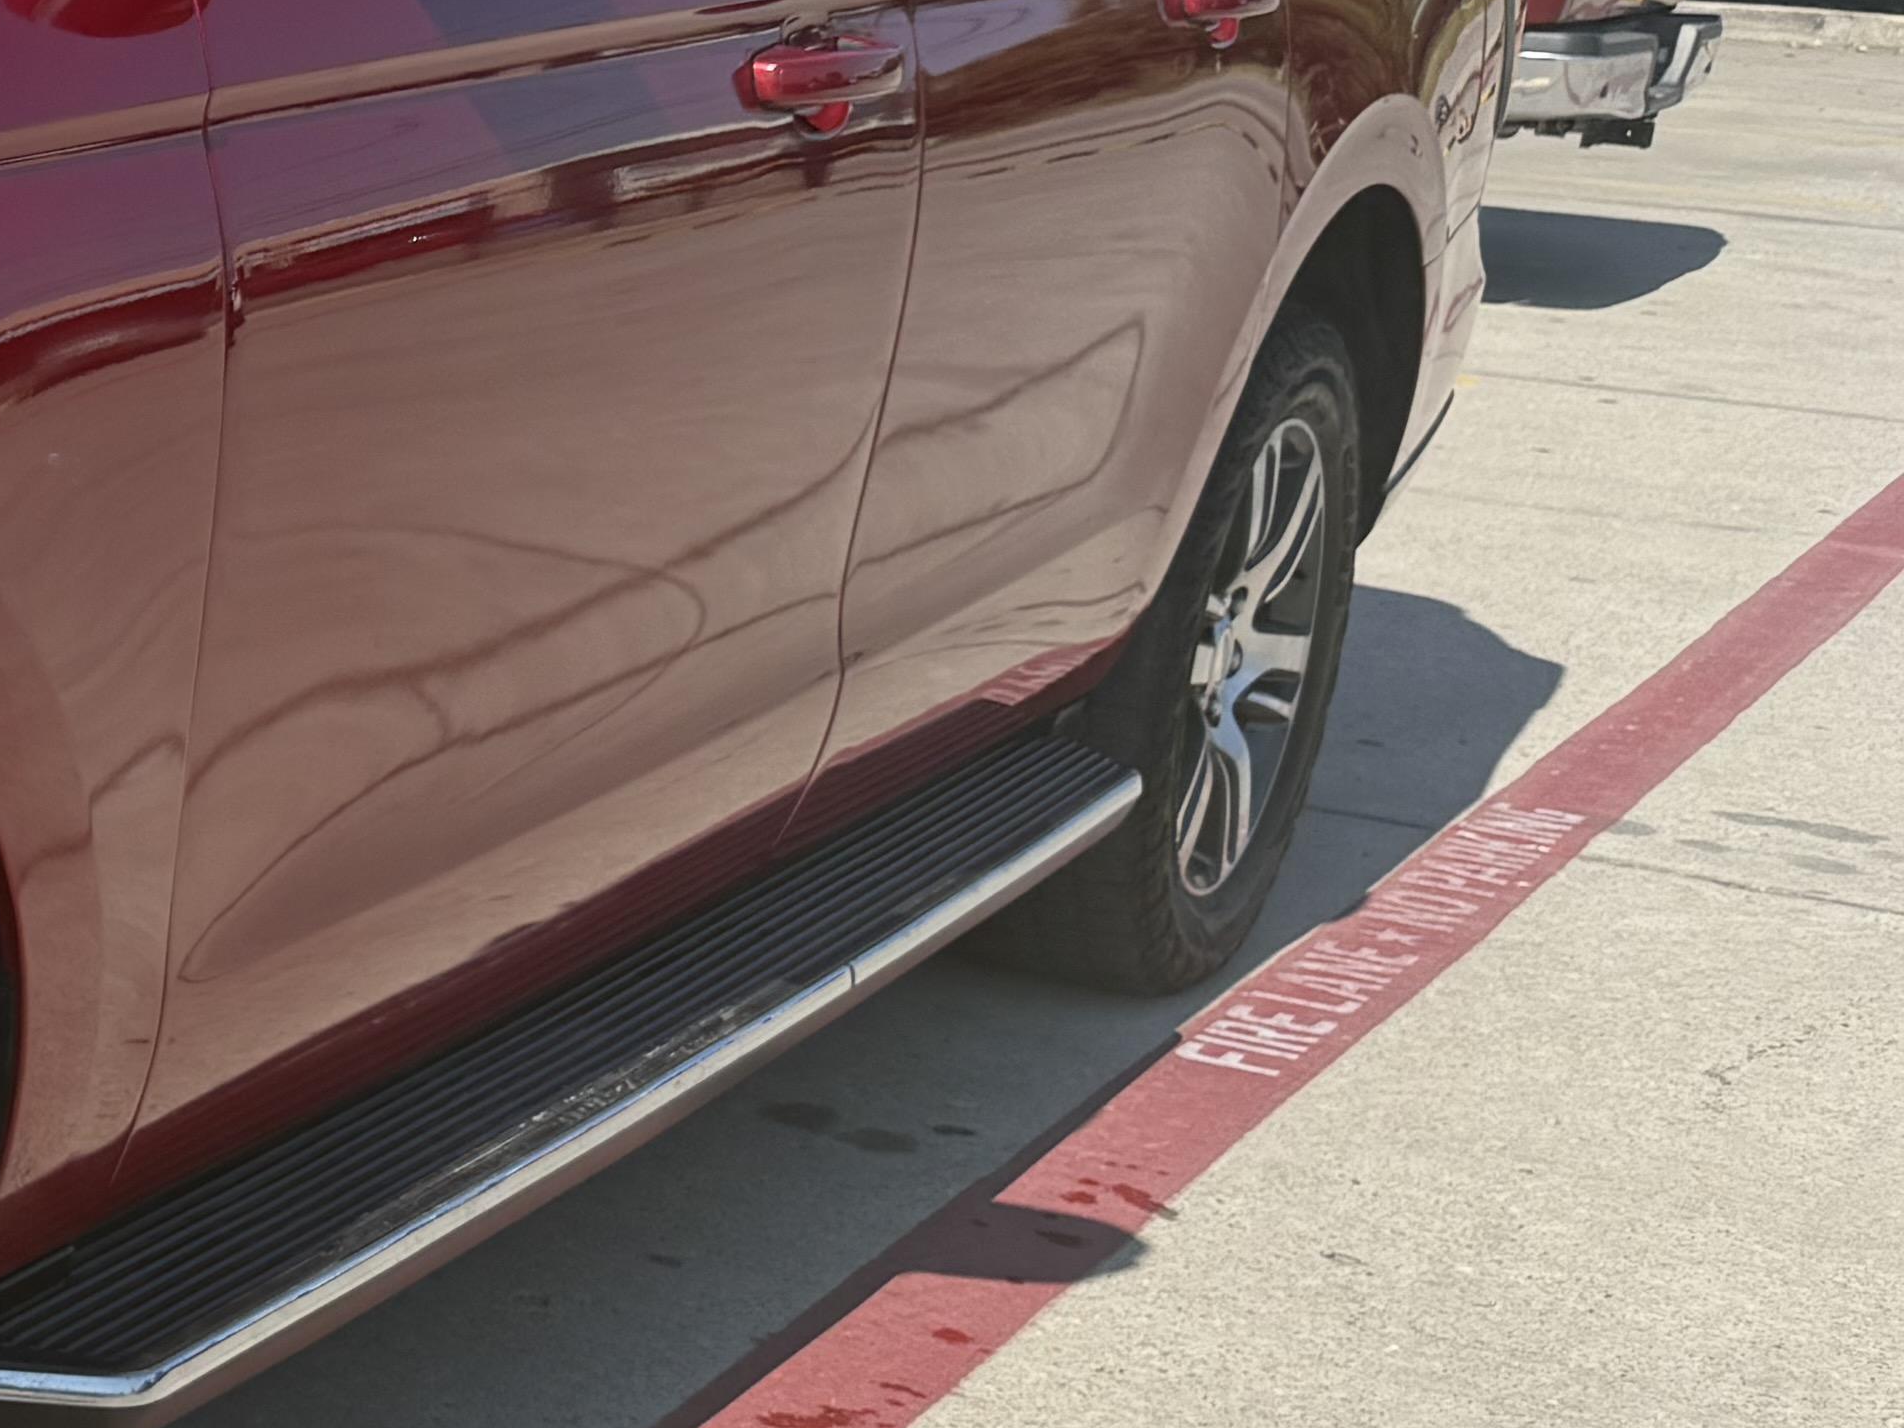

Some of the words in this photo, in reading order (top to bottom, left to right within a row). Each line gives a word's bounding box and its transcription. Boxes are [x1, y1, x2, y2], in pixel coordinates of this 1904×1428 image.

[1398, 801, 1587, 899] PARKING
[1361, 888, 1480, 934] NO
[1242, 938, 1420, 1014] LANE
[1174, 1003, 1339, 1077] FIRE
